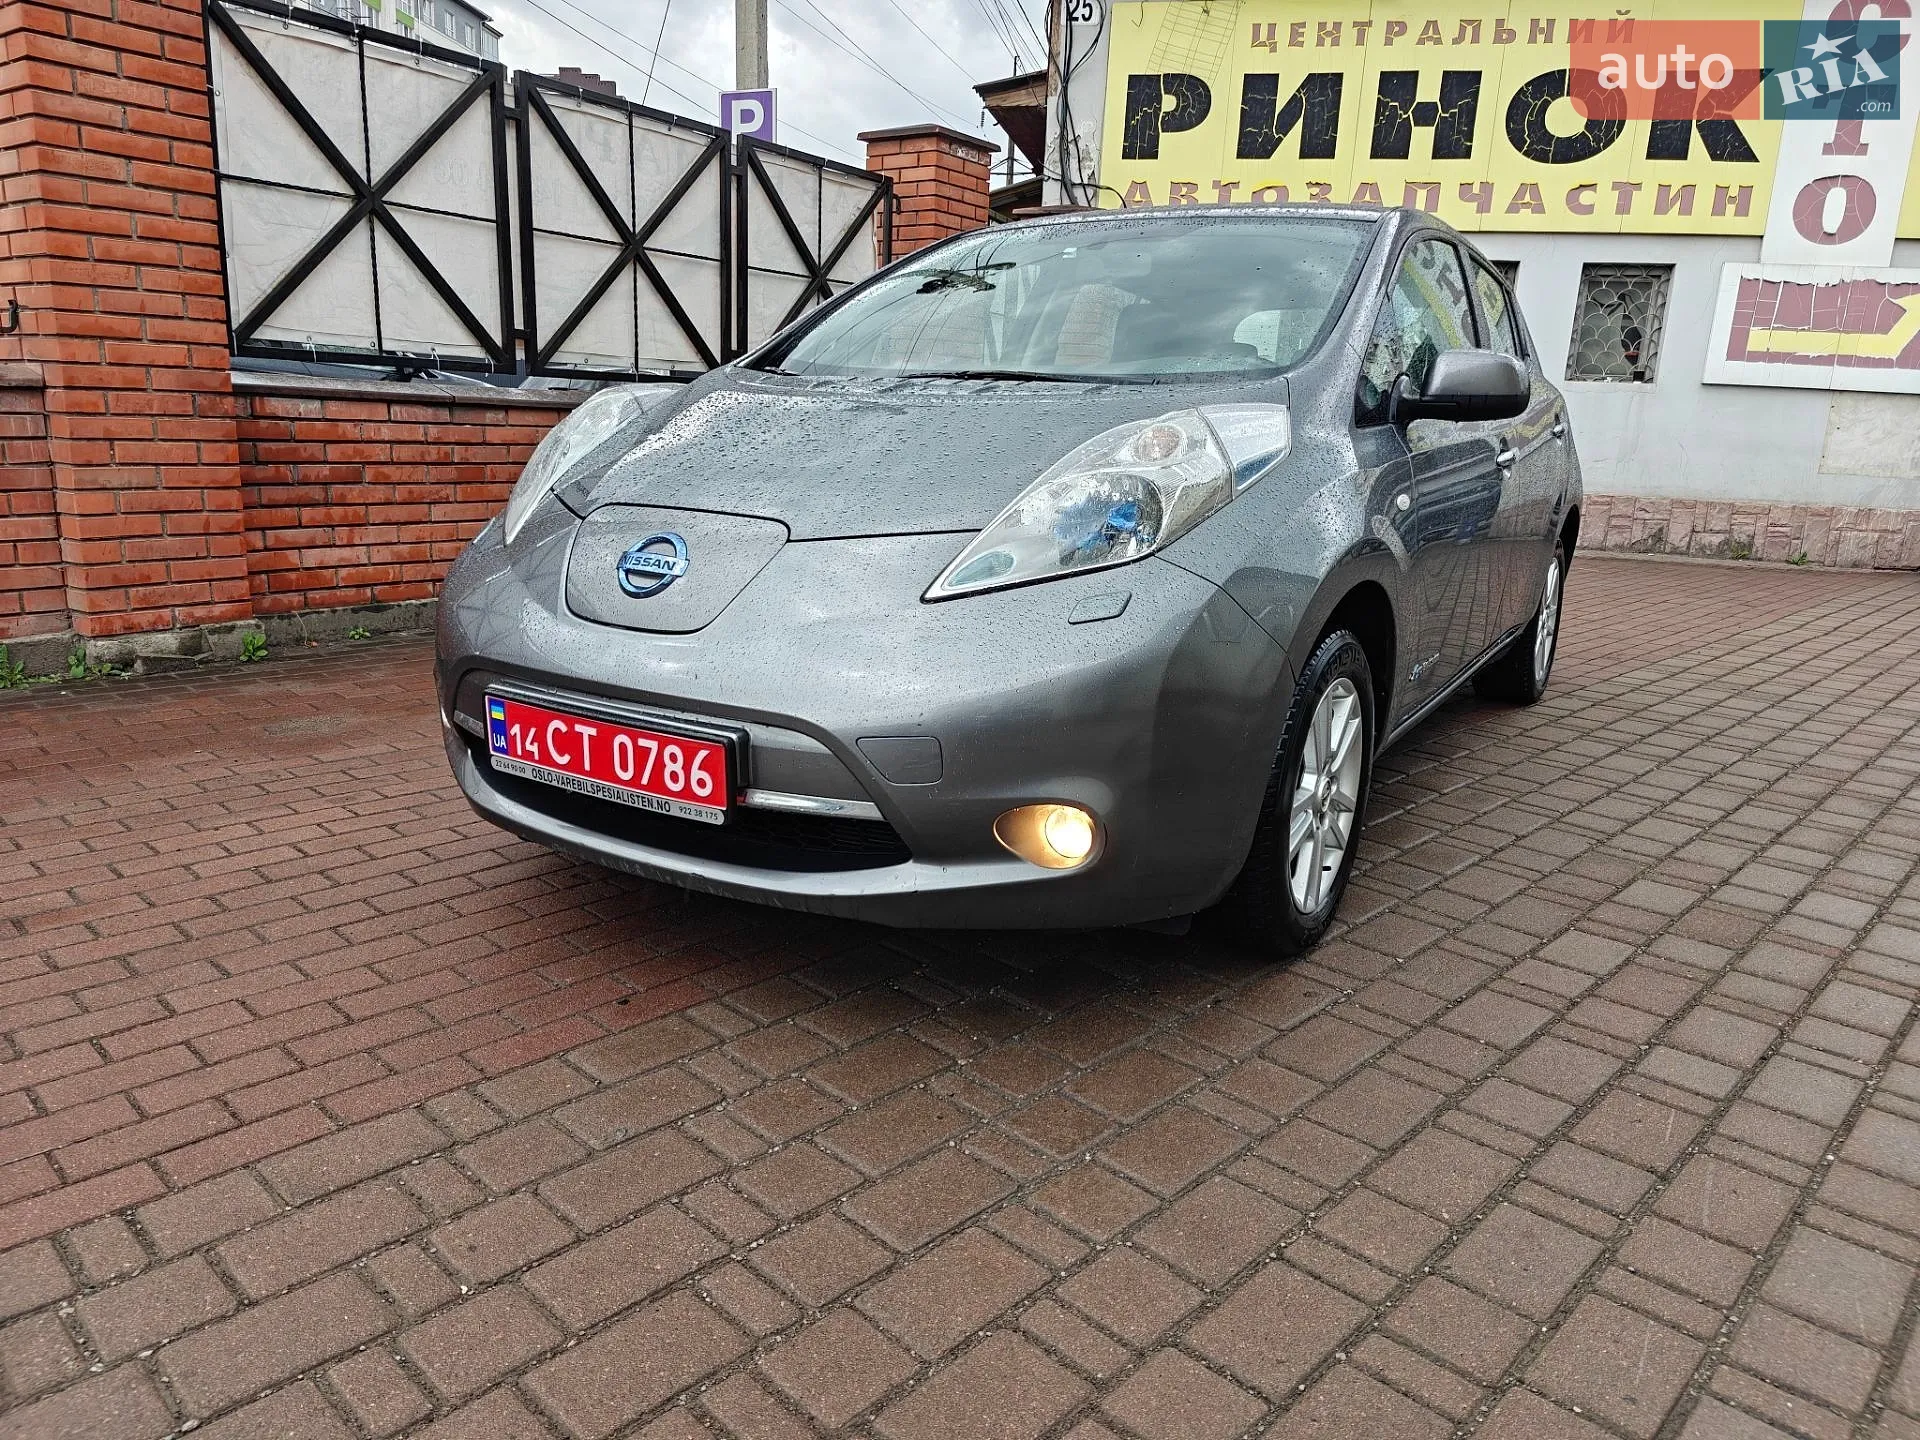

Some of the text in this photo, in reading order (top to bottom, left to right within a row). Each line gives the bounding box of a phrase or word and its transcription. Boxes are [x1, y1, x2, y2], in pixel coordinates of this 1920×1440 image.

[1068, 0, 1093, 22] 25
[1250, 9, 1636, 53] ЦЕНТРАЛЬНИЙ
[731, 99, 765, 145] P
[1121, 68, 1775, 164] РИНОК
[1121, 179, 1754, 217] АВТОЗАПЧАСТИН
[623, 555, 677, 571] NISSAN
[493, 733, 507, 750] UA
[613, 733, 713, 798] 0786
[531, 768, 671, 812] OSLO-VAREBILSPESIALISTEN.NO
[678, 805, 692, 816] 922
[705, 811, 719, 821] 175
